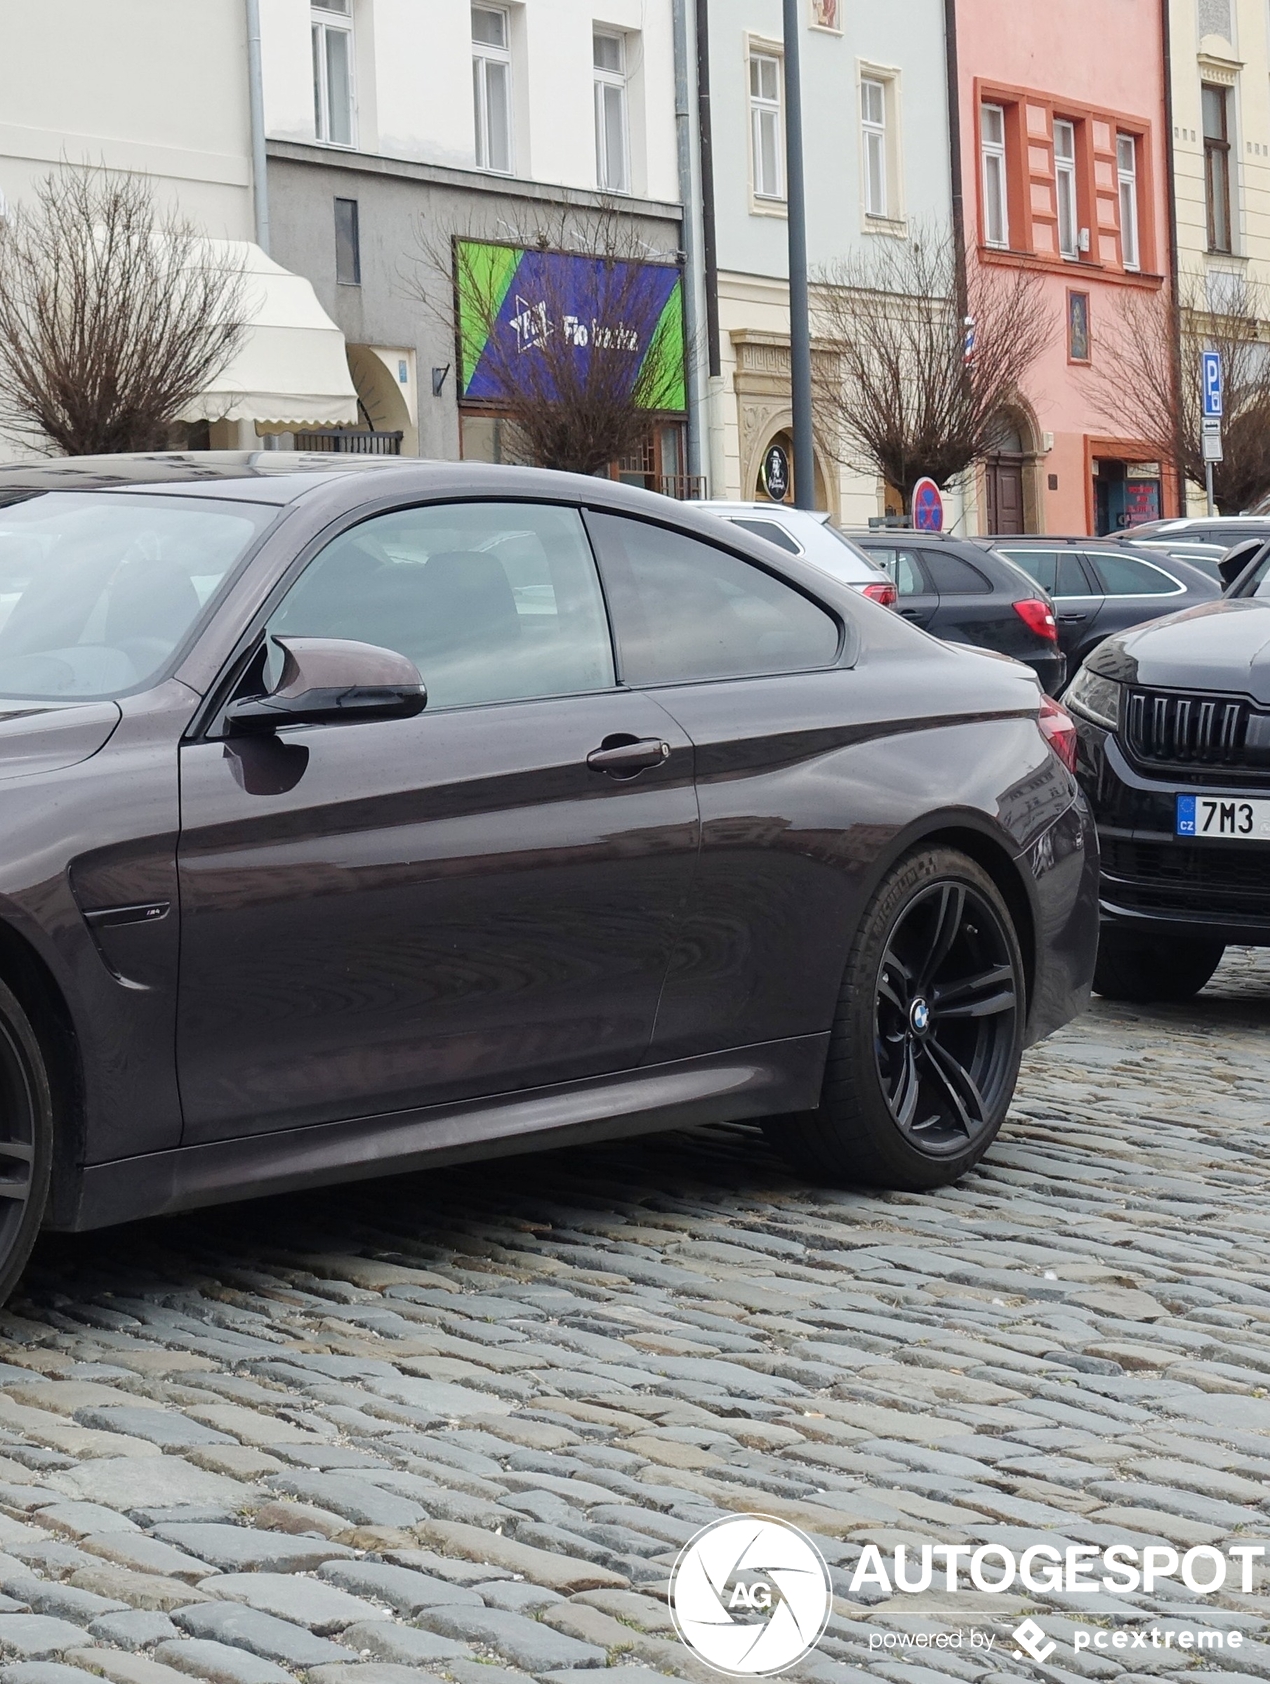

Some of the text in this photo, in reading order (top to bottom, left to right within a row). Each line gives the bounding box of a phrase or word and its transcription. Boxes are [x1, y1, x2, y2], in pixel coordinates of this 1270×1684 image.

[1207, 360, 1218, 396] P
[1180, 820, 1194, 831] CZ
[1202, 802, 1253, 835] 7M3
